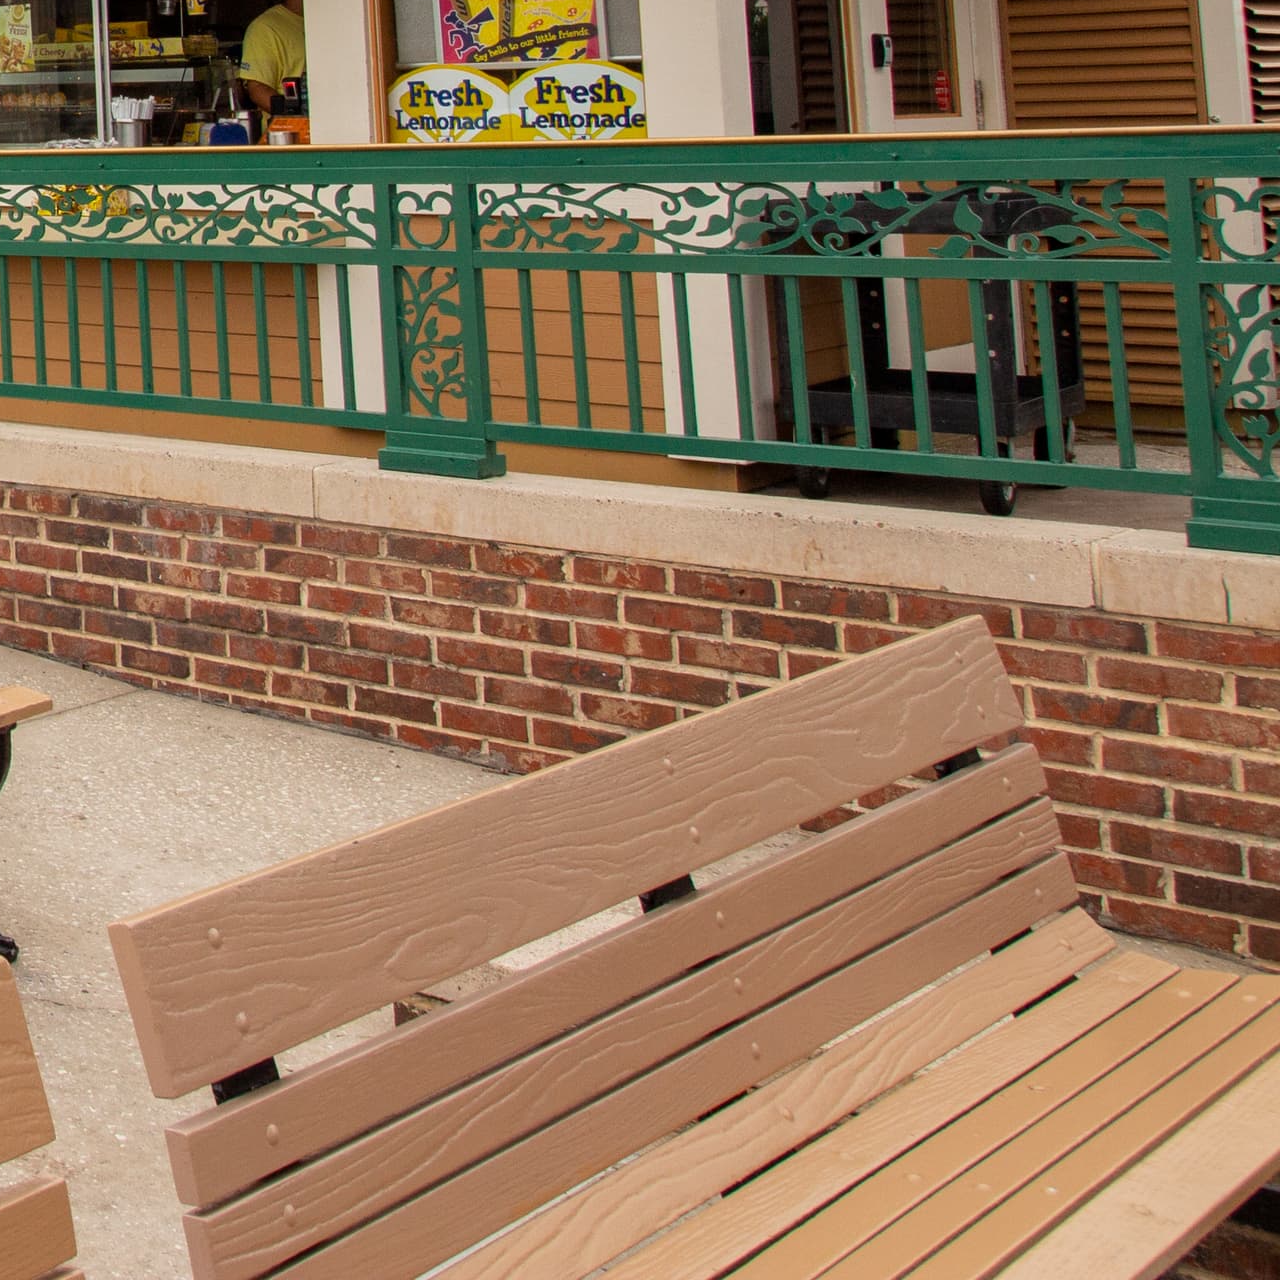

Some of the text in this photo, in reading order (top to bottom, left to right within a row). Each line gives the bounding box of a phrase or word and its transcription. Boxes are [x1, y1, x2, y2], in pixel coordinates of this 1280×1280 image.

[488, 45, 508, 58] hello
[508, 41, 518, 50] to
[535, 33, 557, 44] little
[407, 79, 484, 108] Fresh
[534, 74, 626, 105] Fresh
[394, 108, 501, 130] Lemonade
[519, 105, 646, 129] Lemonade
